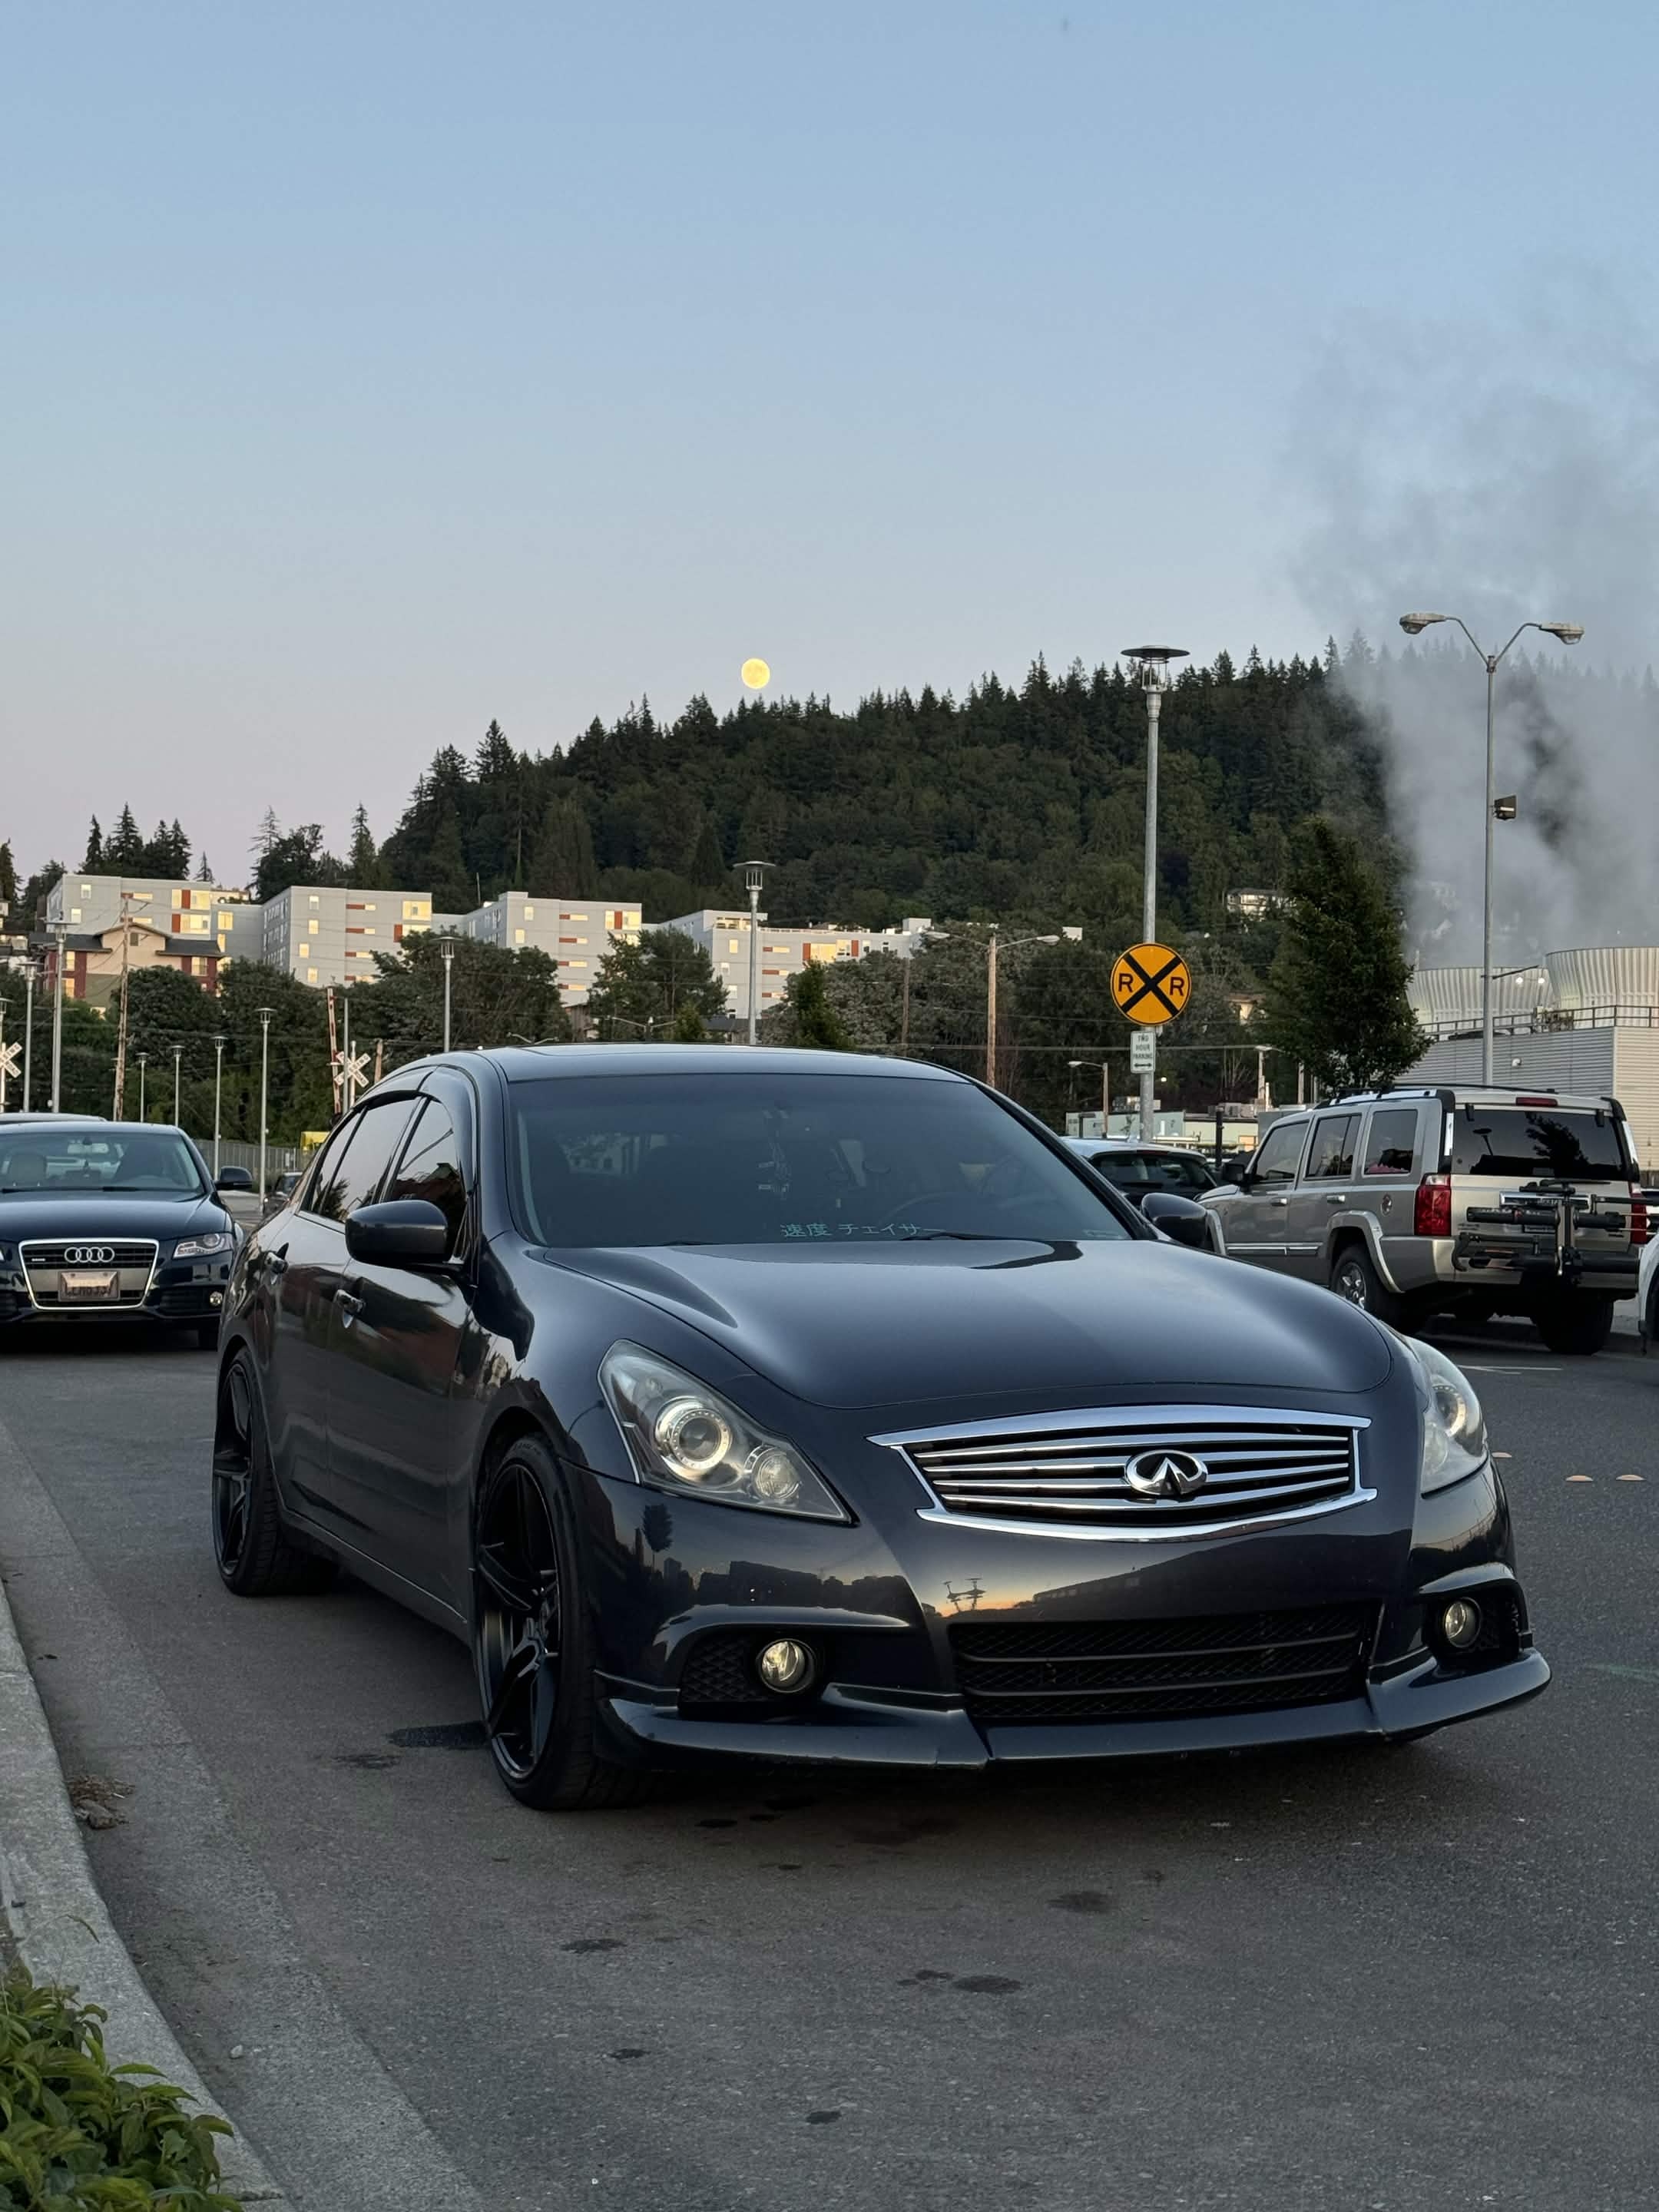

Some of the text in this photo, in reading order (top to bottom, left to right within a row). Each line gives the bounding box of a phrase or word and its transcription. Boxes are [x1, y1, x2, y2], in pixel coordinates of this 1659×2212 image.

[1118, 972, 1184, 996] R R
[780, 1223, 832, 1237] 速度
